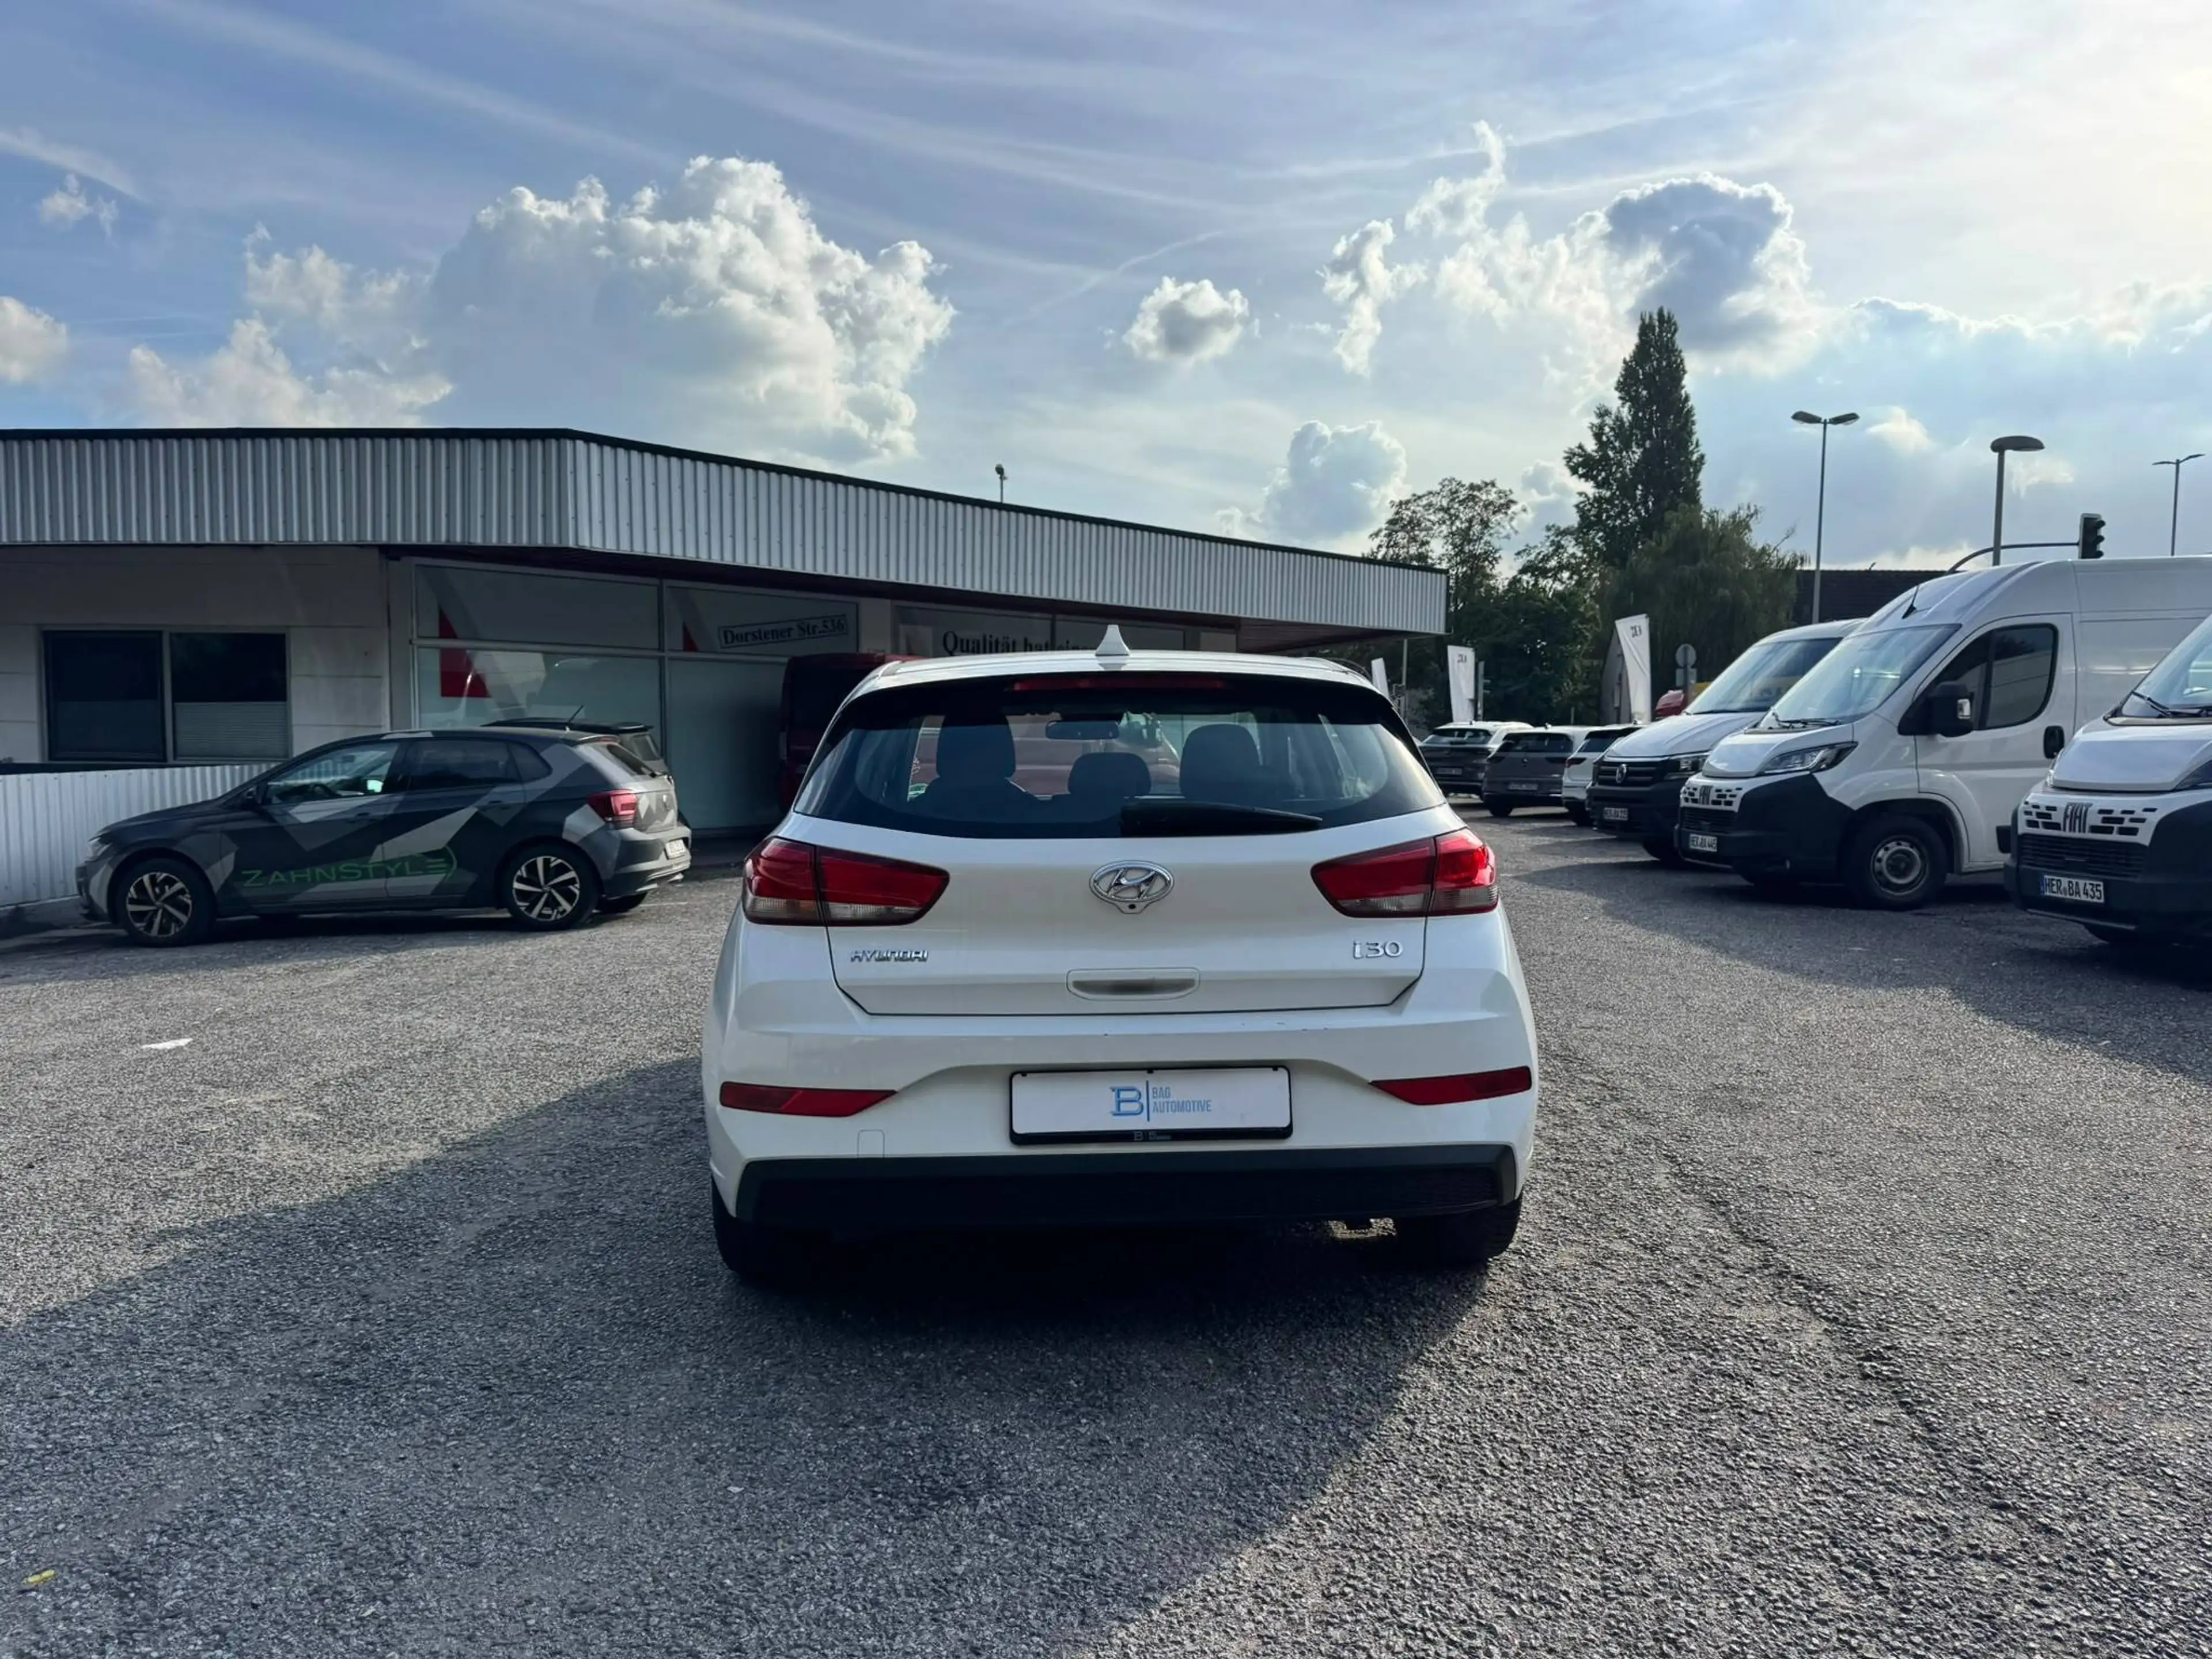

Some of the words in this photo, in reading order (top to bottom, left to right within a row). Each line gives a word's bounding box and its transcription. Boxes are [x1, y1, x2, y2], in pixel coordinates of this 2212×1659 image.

[723, 627, 794, 645] Dorstener
[942, 630, 1017, 656] Qualität
[2063, 802, 2093, 834] FIAT
[241, 858, 448, 887] ZAHNSTYLE
[2046, 876, 2062, 894] HER
[2067, 880, 2081, 899] BA
[2083, 882, 2102, 900] 435
[850, 949, 929, 963] HYUNDAI
[1152, 1086, 1171, 1099] BAG
[1152, 1099, 1212, 1113] AUTOMOTIVE
